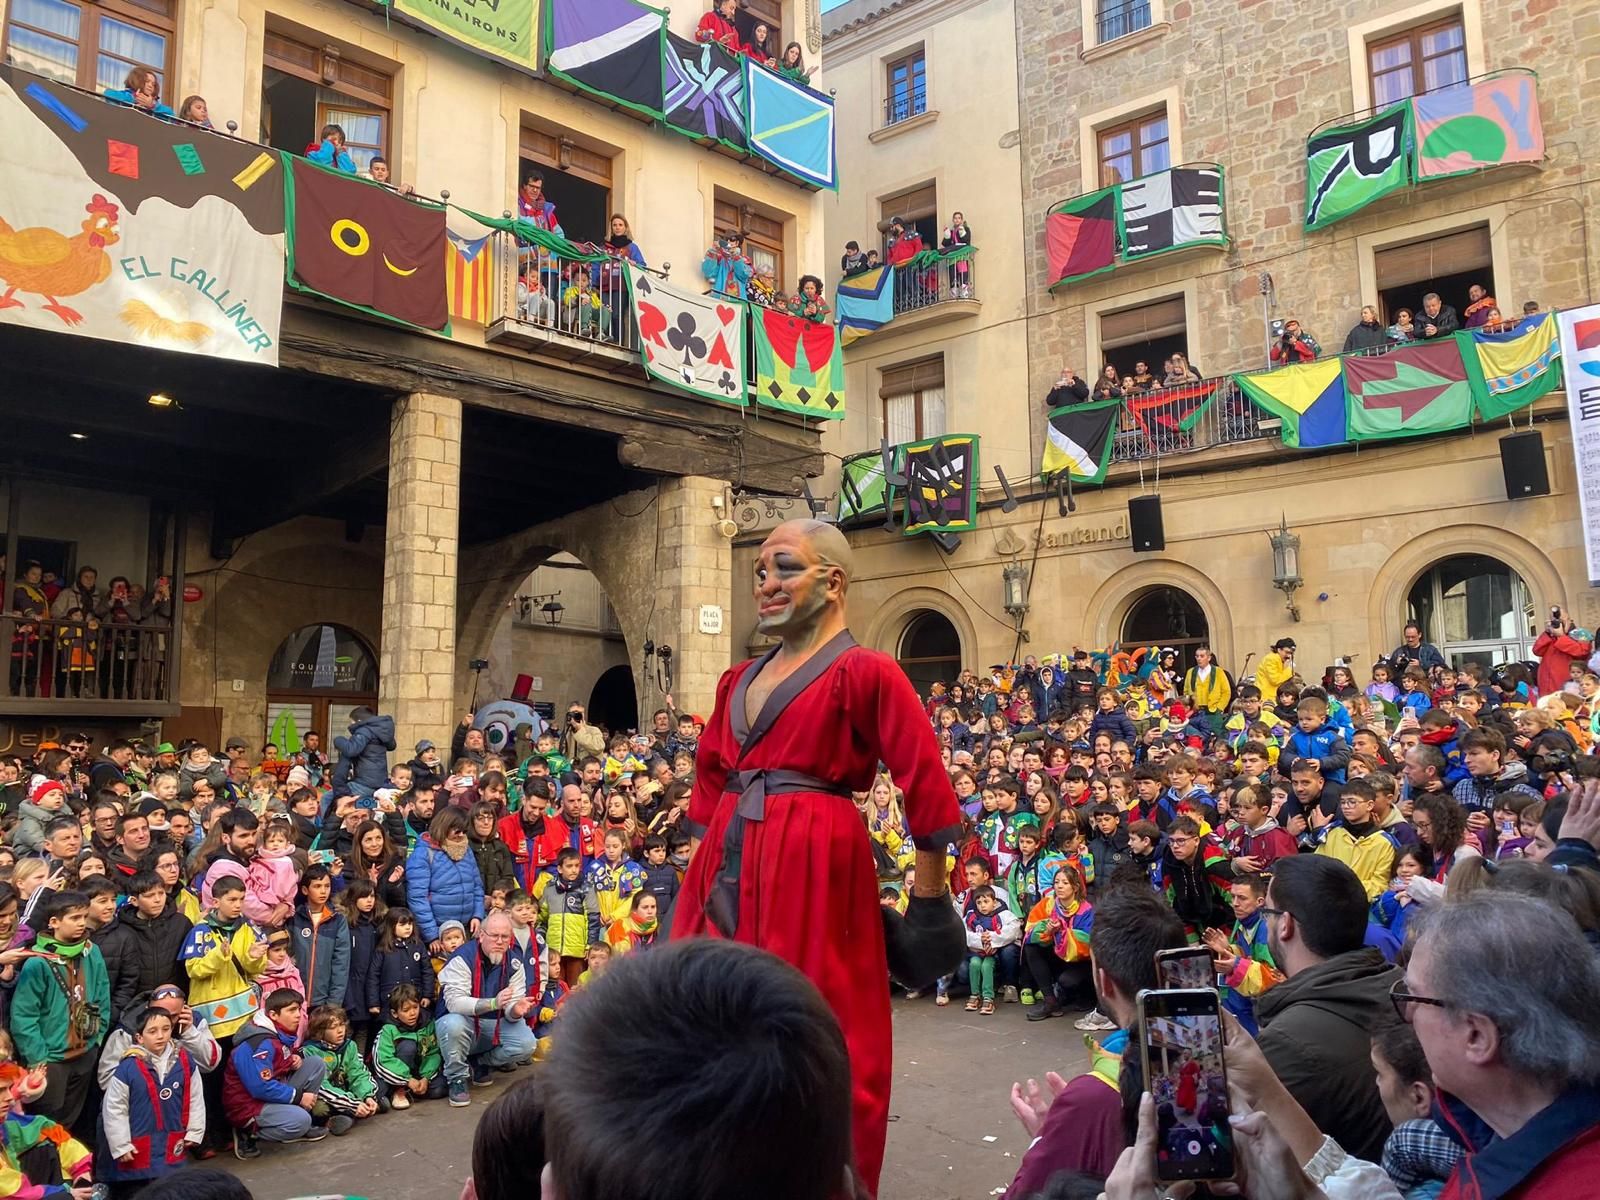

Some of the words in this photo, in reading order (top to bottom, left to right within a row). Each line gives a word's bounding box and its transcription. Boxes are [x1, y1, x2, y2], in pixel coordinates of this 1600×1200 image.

[429, 0, 518, 42] INAIRONS
[120, 256, 161, 280] EL
[1031, 514, 1130, 549] Santand
[291, 662, 351, 673] EQUILIBRI
